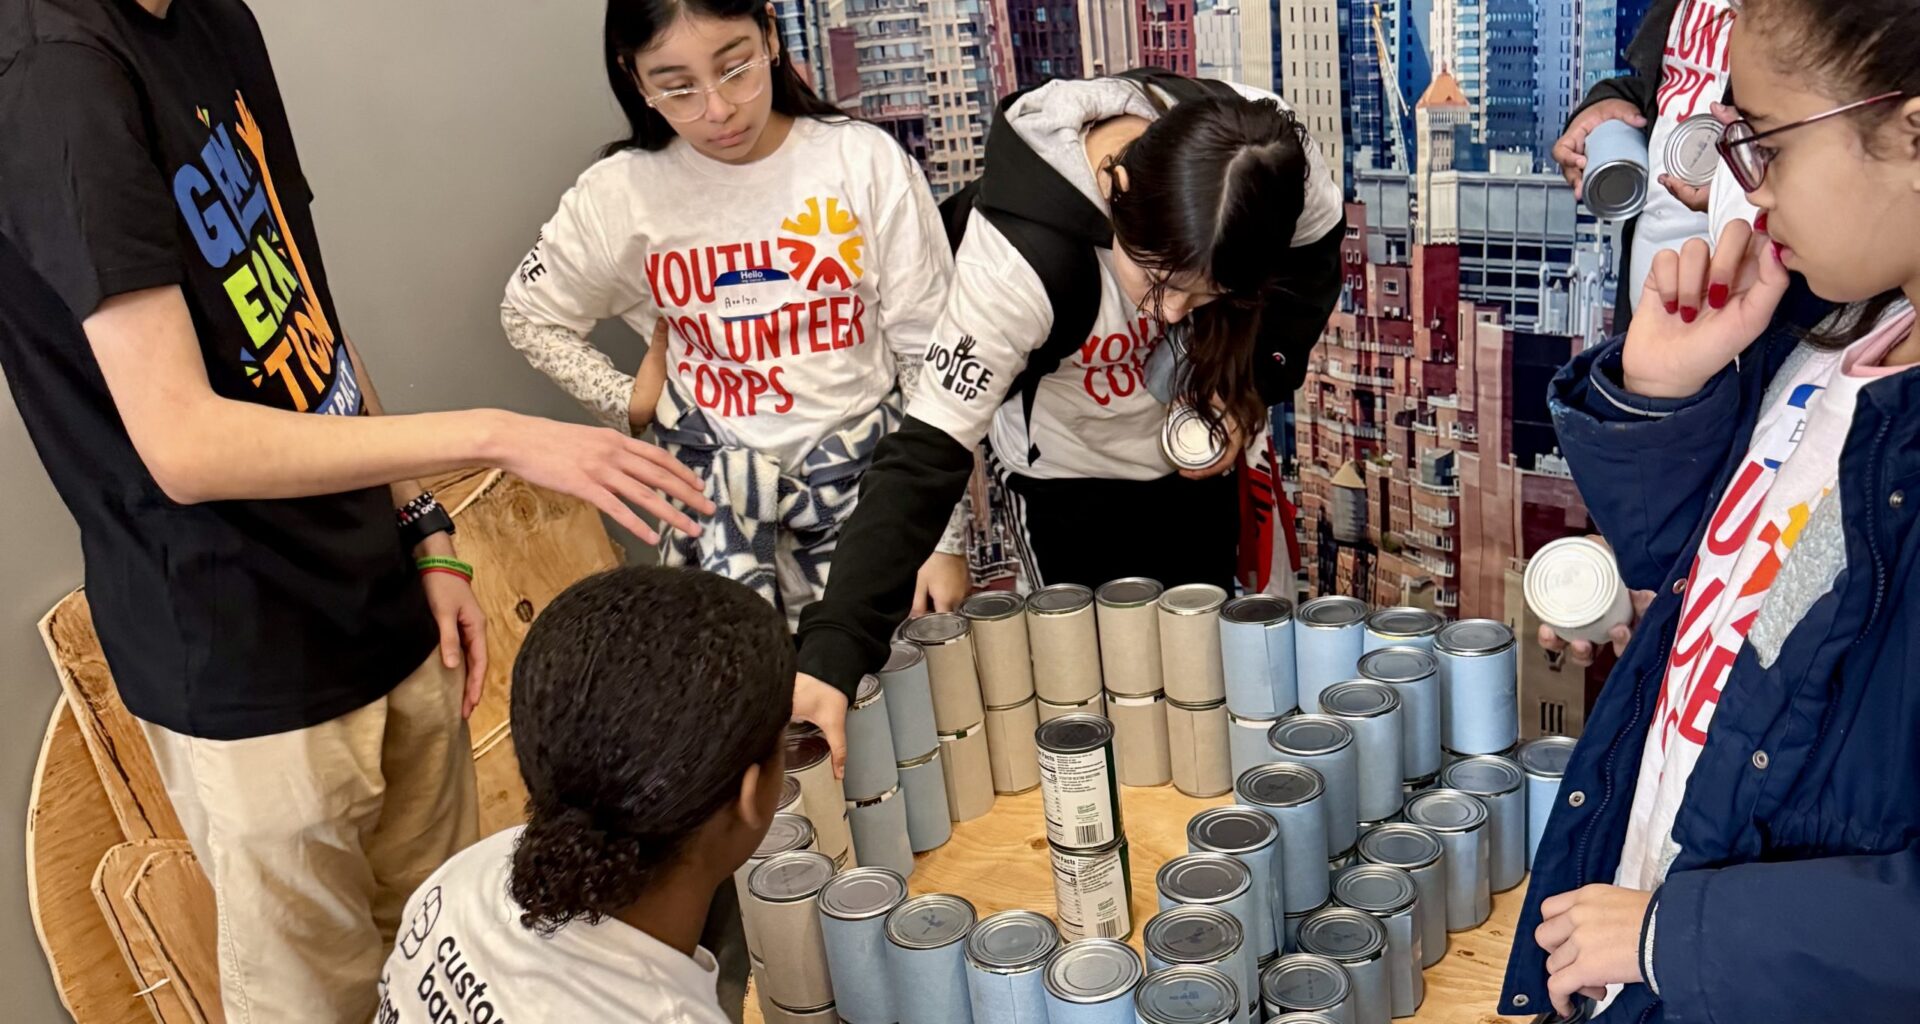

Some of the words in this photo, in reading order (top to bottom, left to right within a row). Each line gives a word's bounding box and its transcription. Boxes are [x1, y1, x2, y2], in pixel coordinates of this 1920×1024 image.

[740, 270, 764, 280] Hello
[324, 360, 357, 416] PACT
[955, 382, 978, 402] up
[418, 961, 469, 1024] ban
[437, 936, 505, 1024] custo
